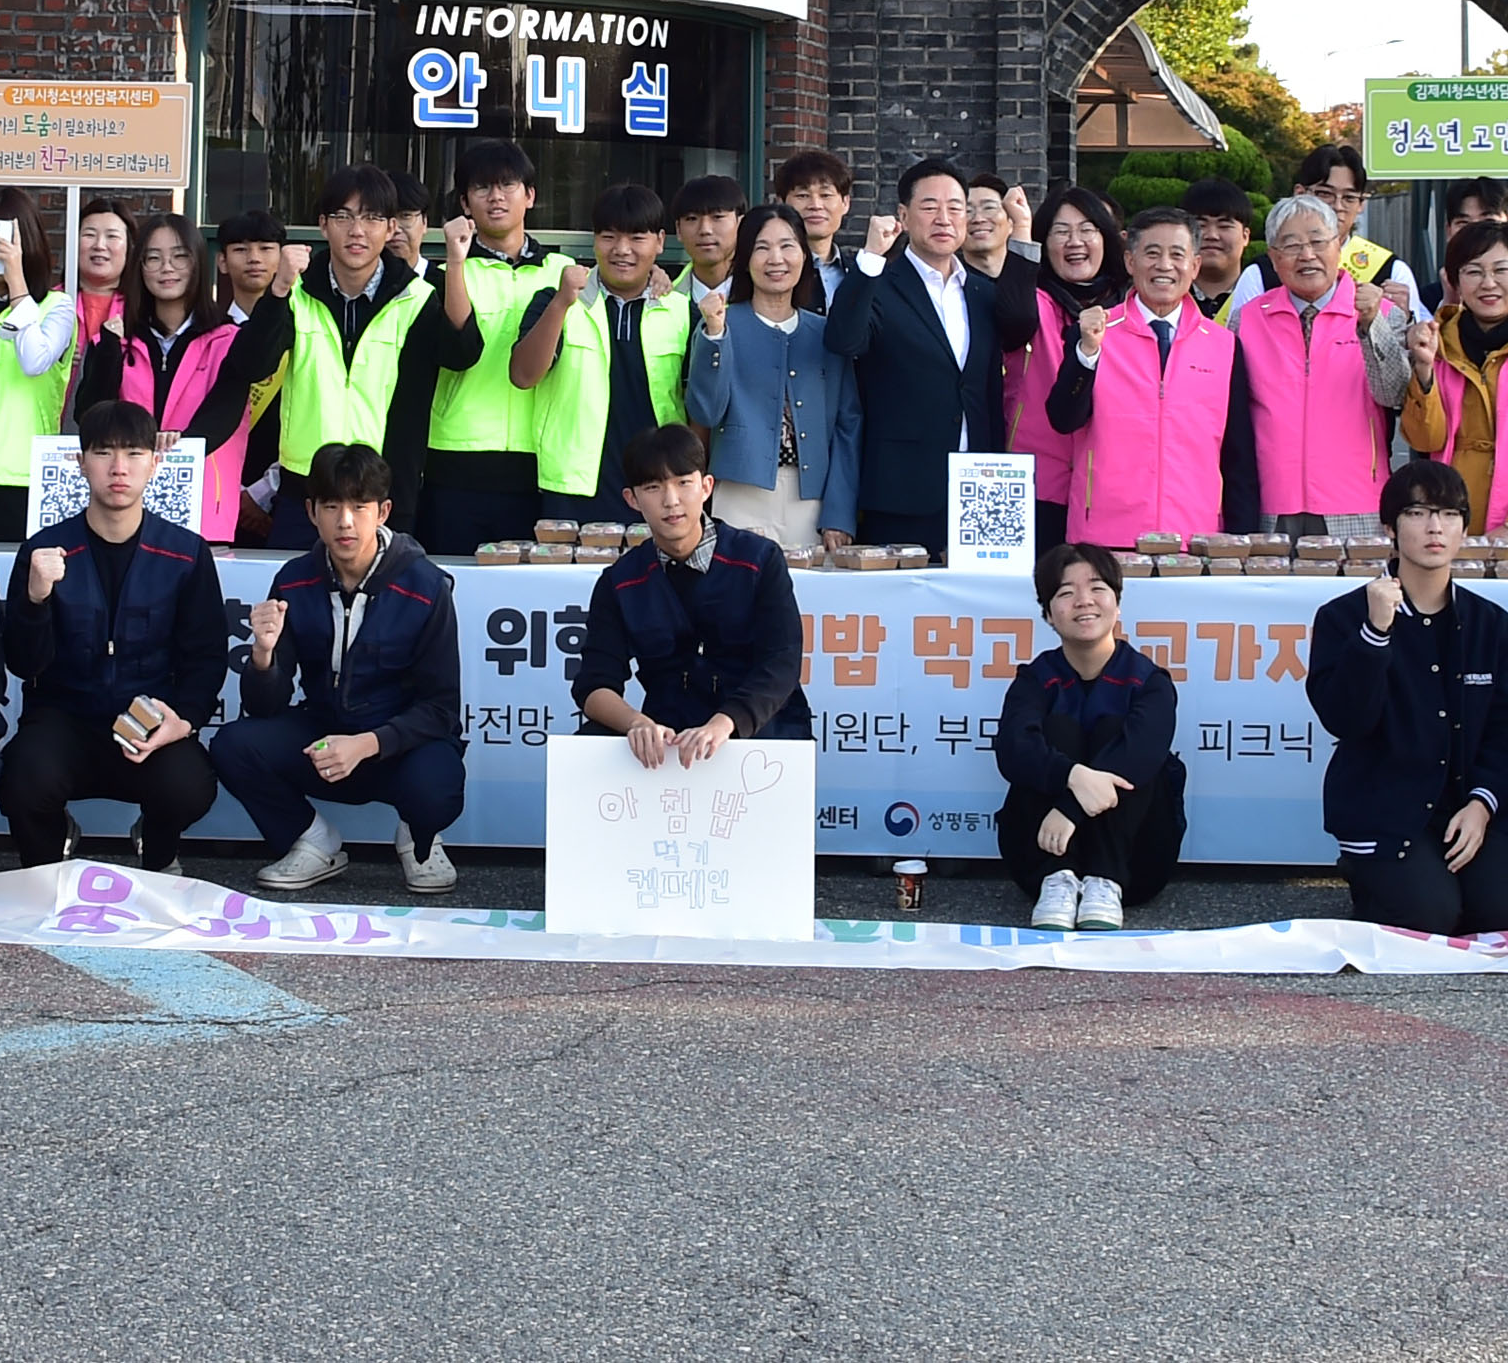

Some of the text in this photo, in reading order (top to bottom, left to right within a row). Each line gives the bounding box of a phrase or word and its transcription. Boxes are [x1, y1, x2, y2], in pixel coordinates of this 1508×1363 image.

[414, 4, 669, 49] INFORMATION
[11, 88, 153, 105] 김제시청소년상담복지센터
[21, 112, 62, 137] 도움이
[65, 119, 125, 137] 필요하나요?
[1388, 119, 1462, 155] 청소년
[40, 145, 80, 172] 친구가
[82, 154, 103, 171] 되어
[105, 154, 172, 173] 드리겠습니다.
[913, 616, 1033, 688] 먹고
[1198, 720, 1312, 762] 피크닉
[653, 840, 709, 867] 먹기
